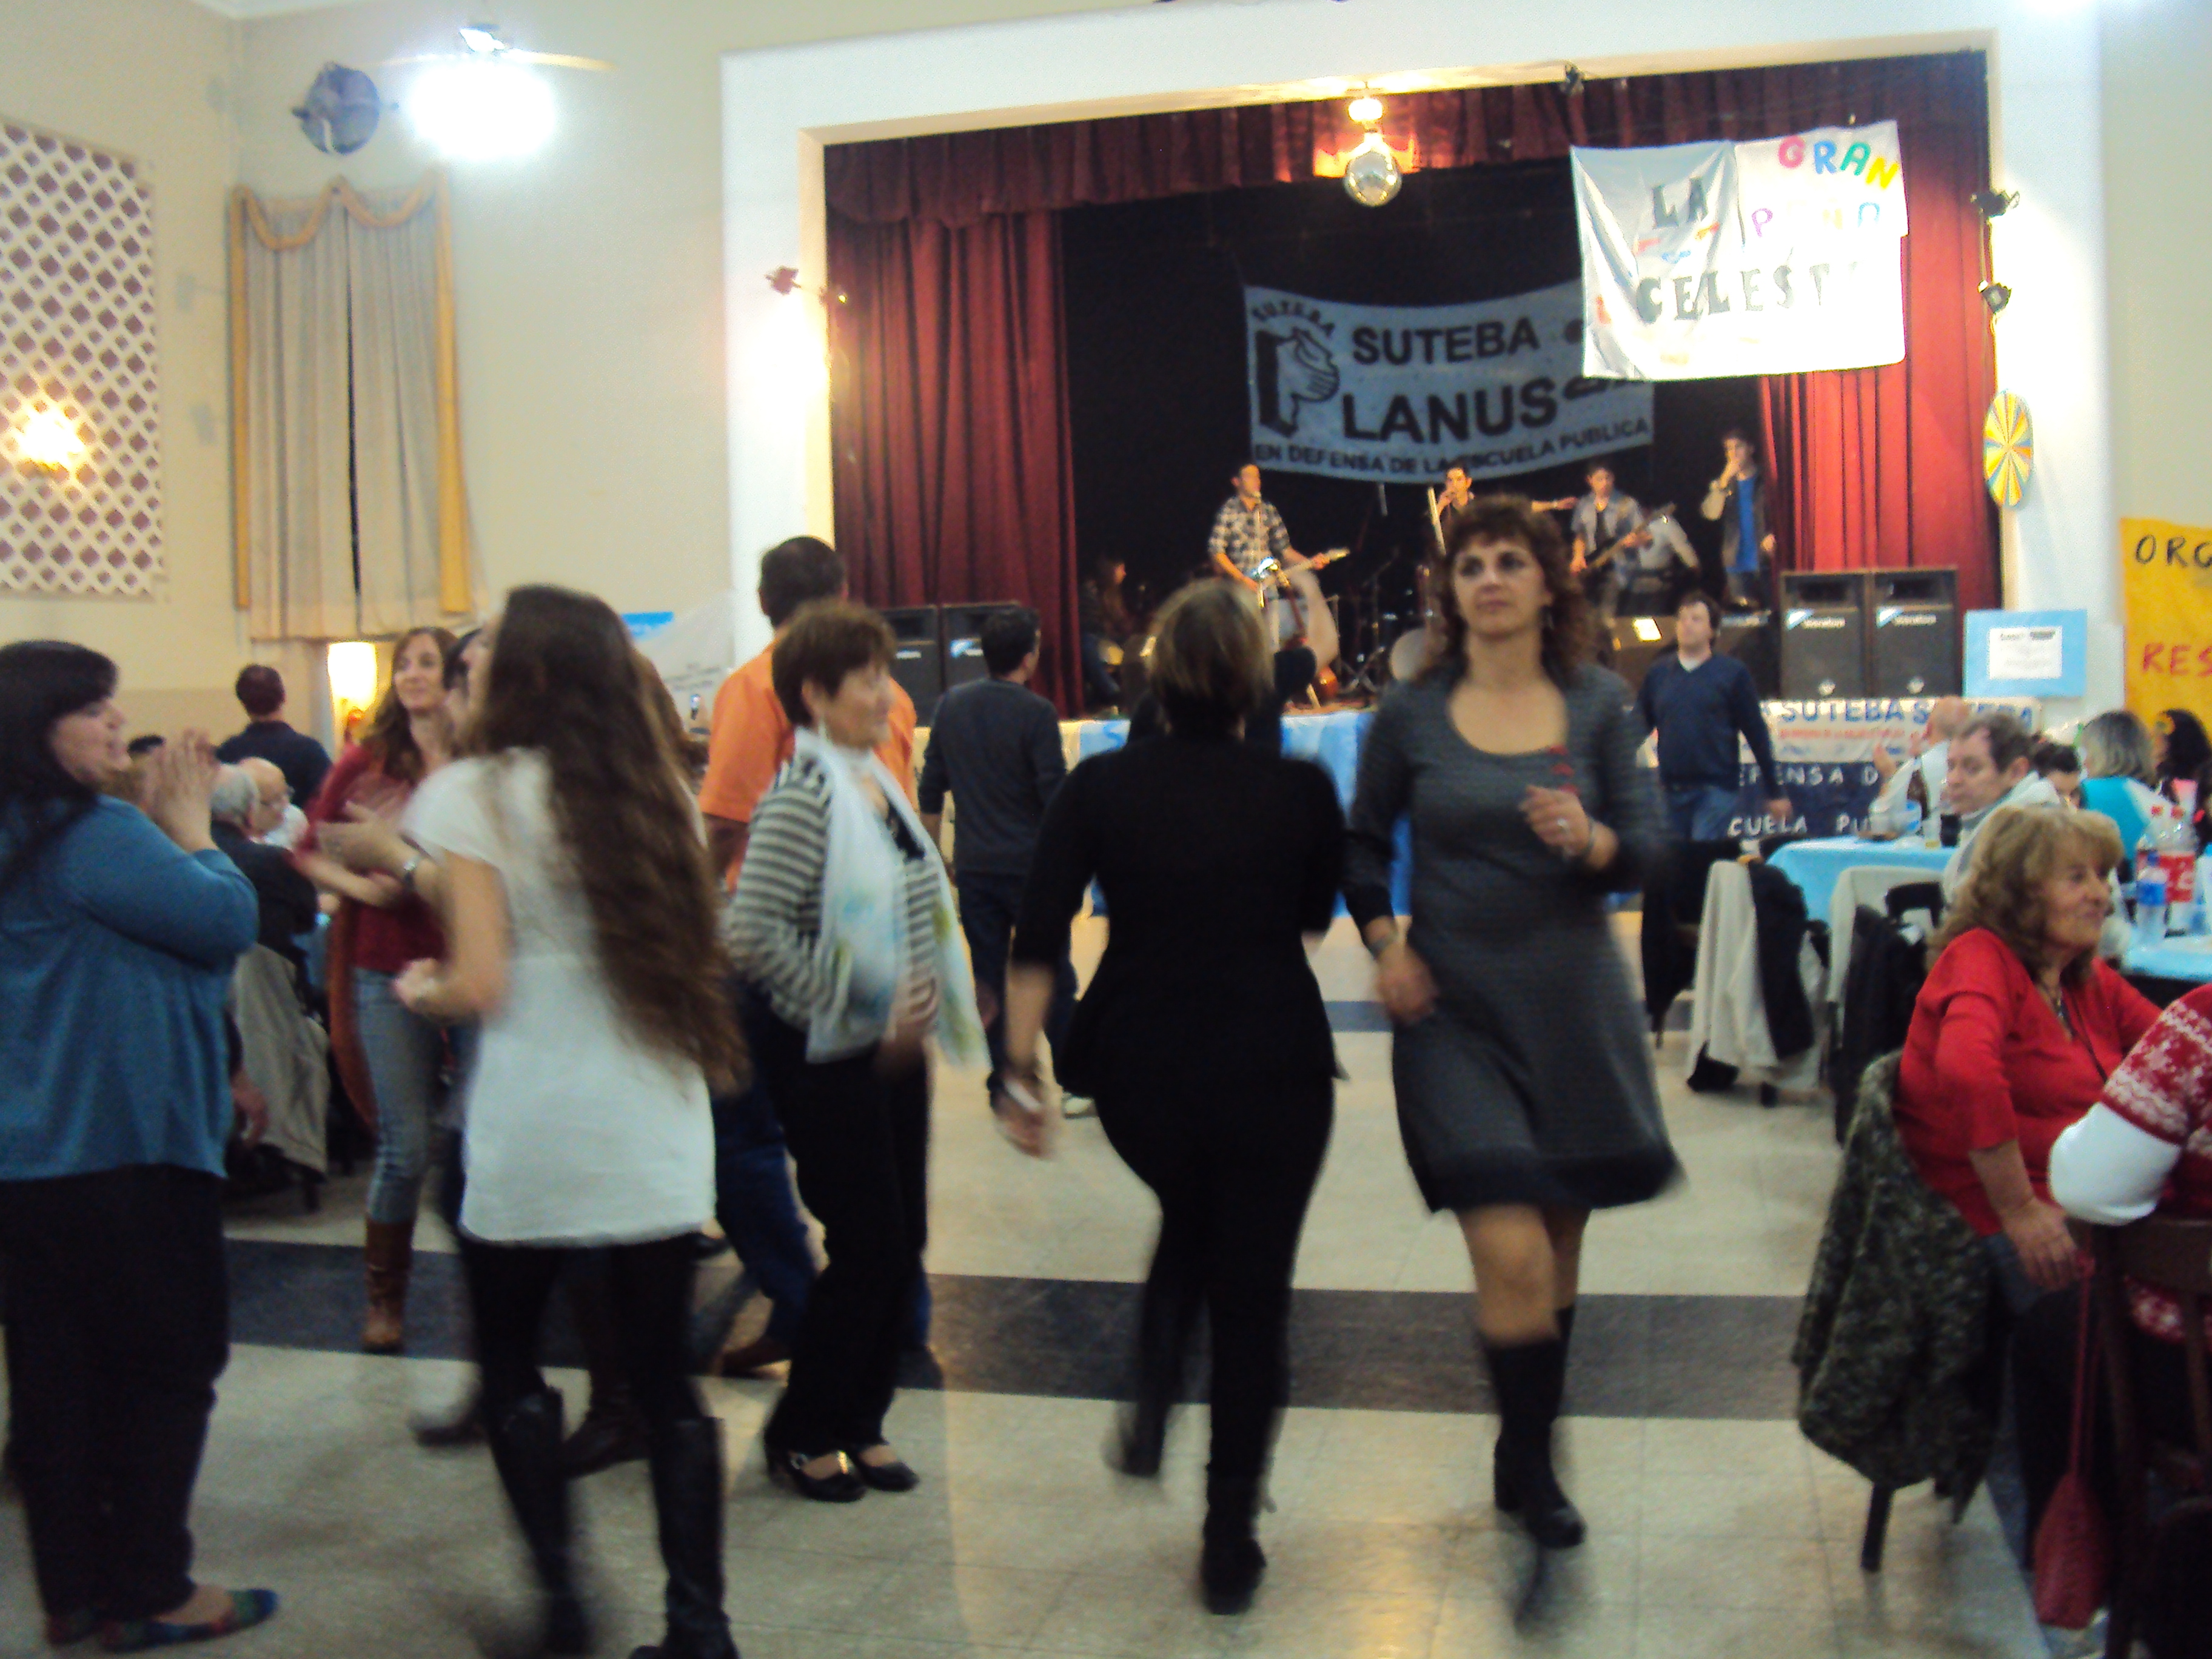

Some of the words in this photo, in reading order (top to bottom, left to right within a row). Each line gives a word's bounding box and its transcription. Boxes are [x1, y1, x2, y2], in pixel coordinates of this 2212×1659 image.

[1777, 135, 1900, 189] GRAN
[1651, 177, 1709, 229] LA
[1637, 261, 1864, 325] CELEST
[1352, 317, 1540, 366] SUTEBA
[1342, 375, 1558, 444] LANUS
[1255, 444, 1282, 461] EN
[1288, 444, 1385, 473] DEFENSA
[1389, 456, 1418, 474] DE
[1558, 417, 1649, 451] PUBLICA
[1780, 701, 1905, 723] SUTEBA
[1728, 813, 1809, 837] CUELA
